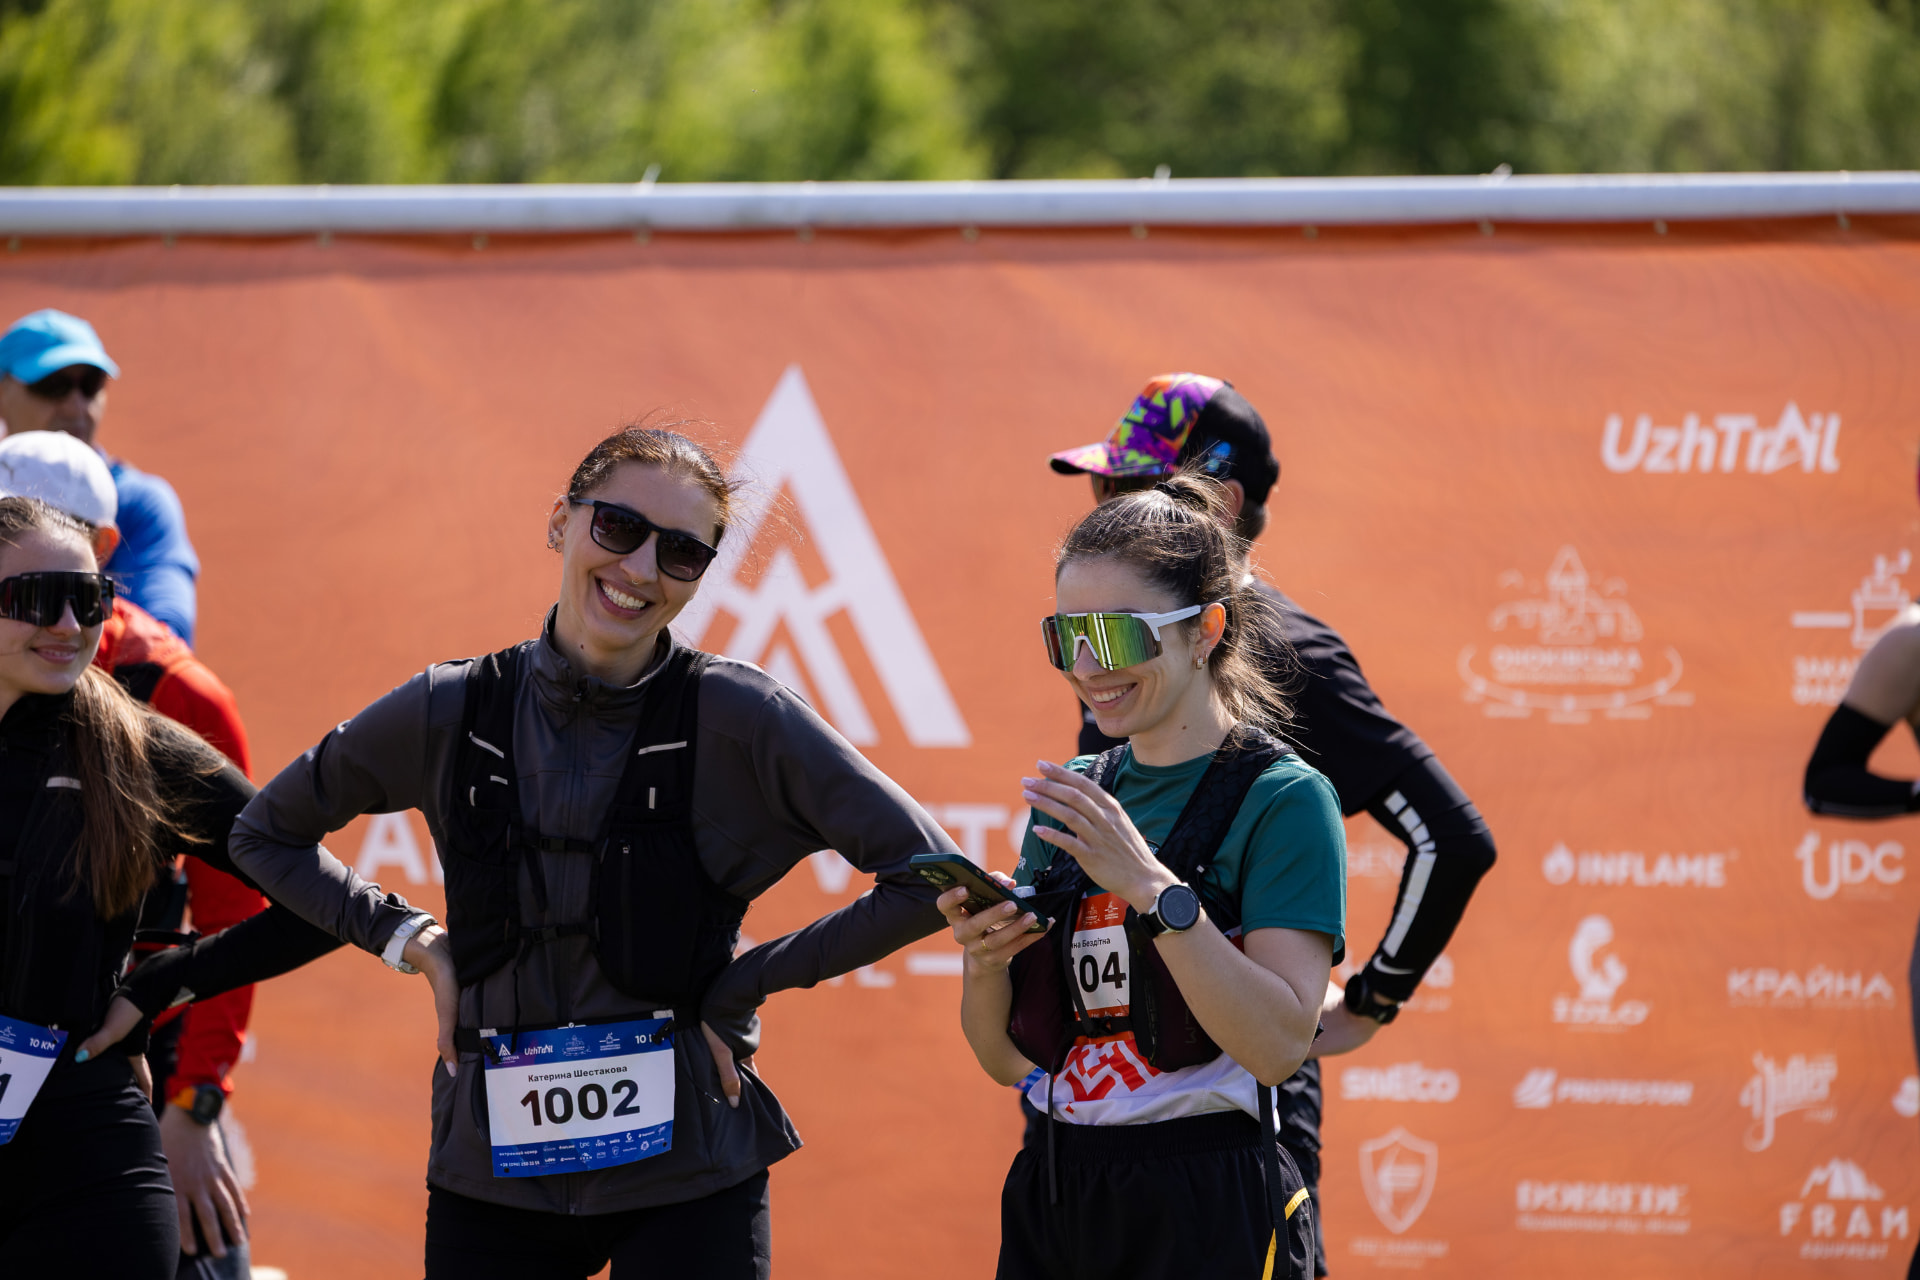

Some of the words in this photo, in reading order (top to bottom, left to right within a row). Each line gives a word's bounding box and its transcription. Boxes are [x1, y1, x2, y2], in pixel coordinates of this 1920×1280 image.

[1578, 851, 1724, 887] INFLAME
[1072, 951, 1127, 993] 04
[528, 1071, 572, 1083] Катерина
[573, 1066, 628, 1078] Шестакова
[520, 1079, 640, 1127] 1002
[1780, 1203, 1908, 1240] FRAM
